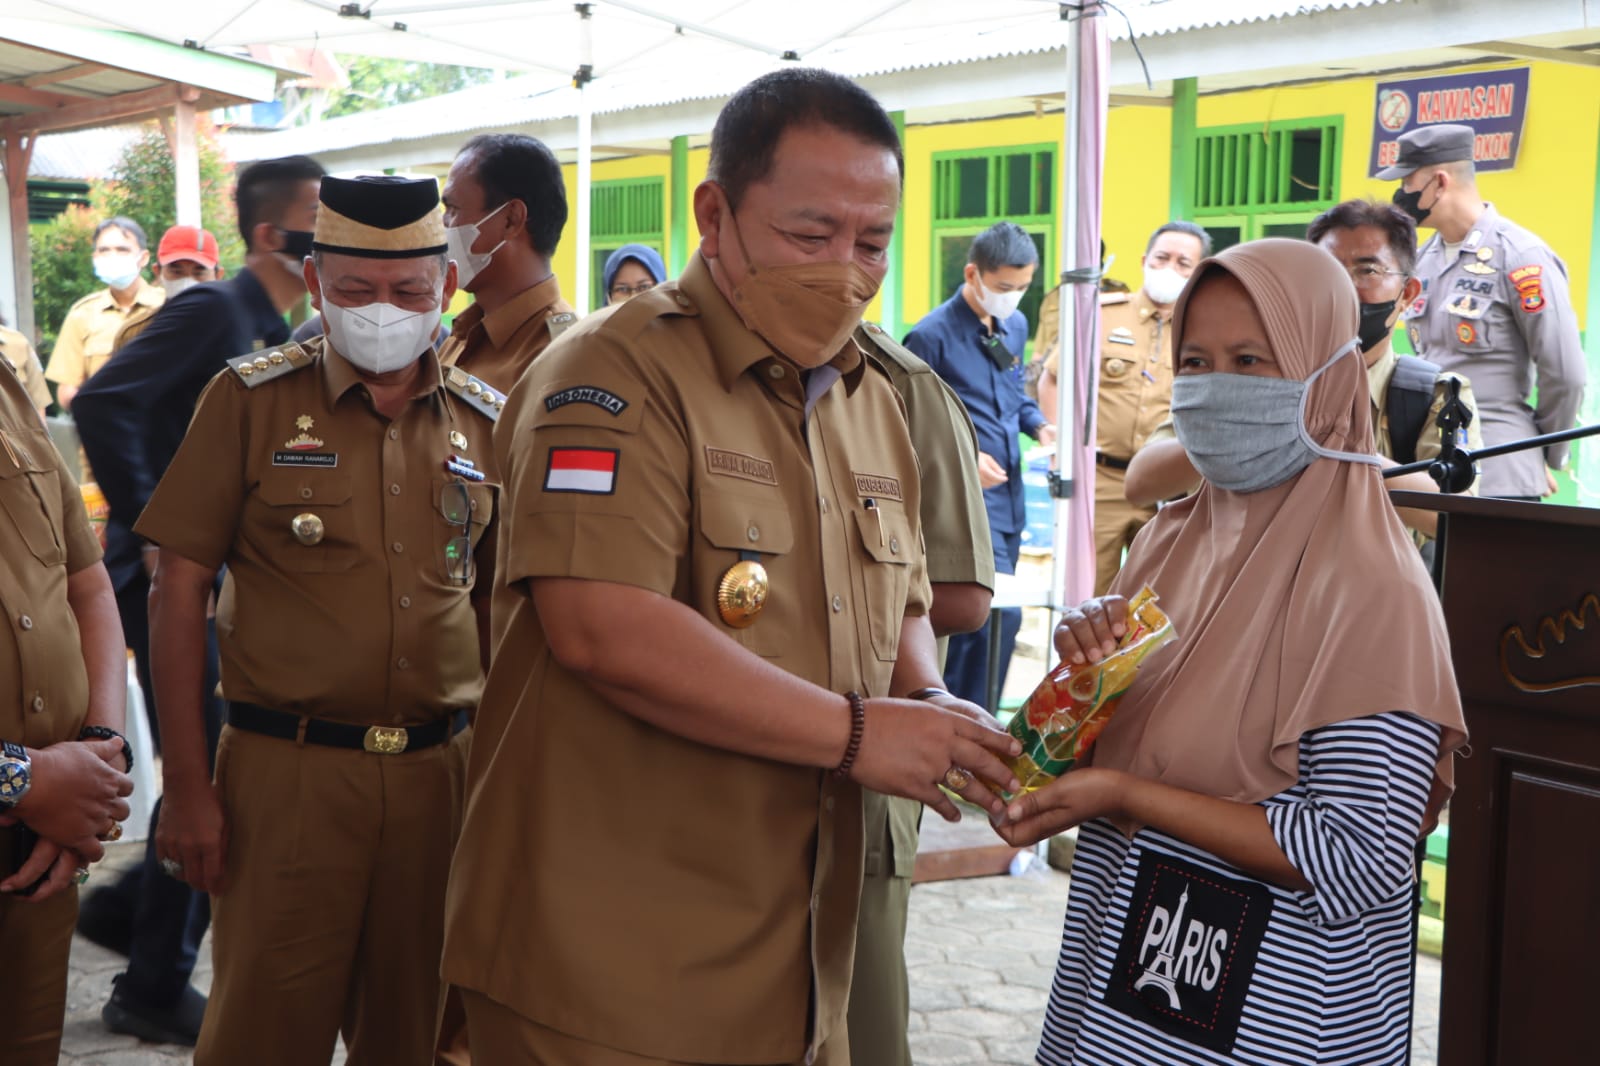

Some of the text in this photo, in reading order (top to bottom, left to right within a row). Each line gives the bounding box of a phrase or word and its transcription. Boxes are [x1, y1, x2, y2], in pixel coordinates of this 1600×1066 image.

[1417, 84, 1514, 124] KAWASAN
[1473, 132, 1513, 162] OKOK
[1455, 278, 1494, 295] POLRI
[547, 388, 623, 413] INDONESIA
[1134, 882, 1228, 1010] PARIS
